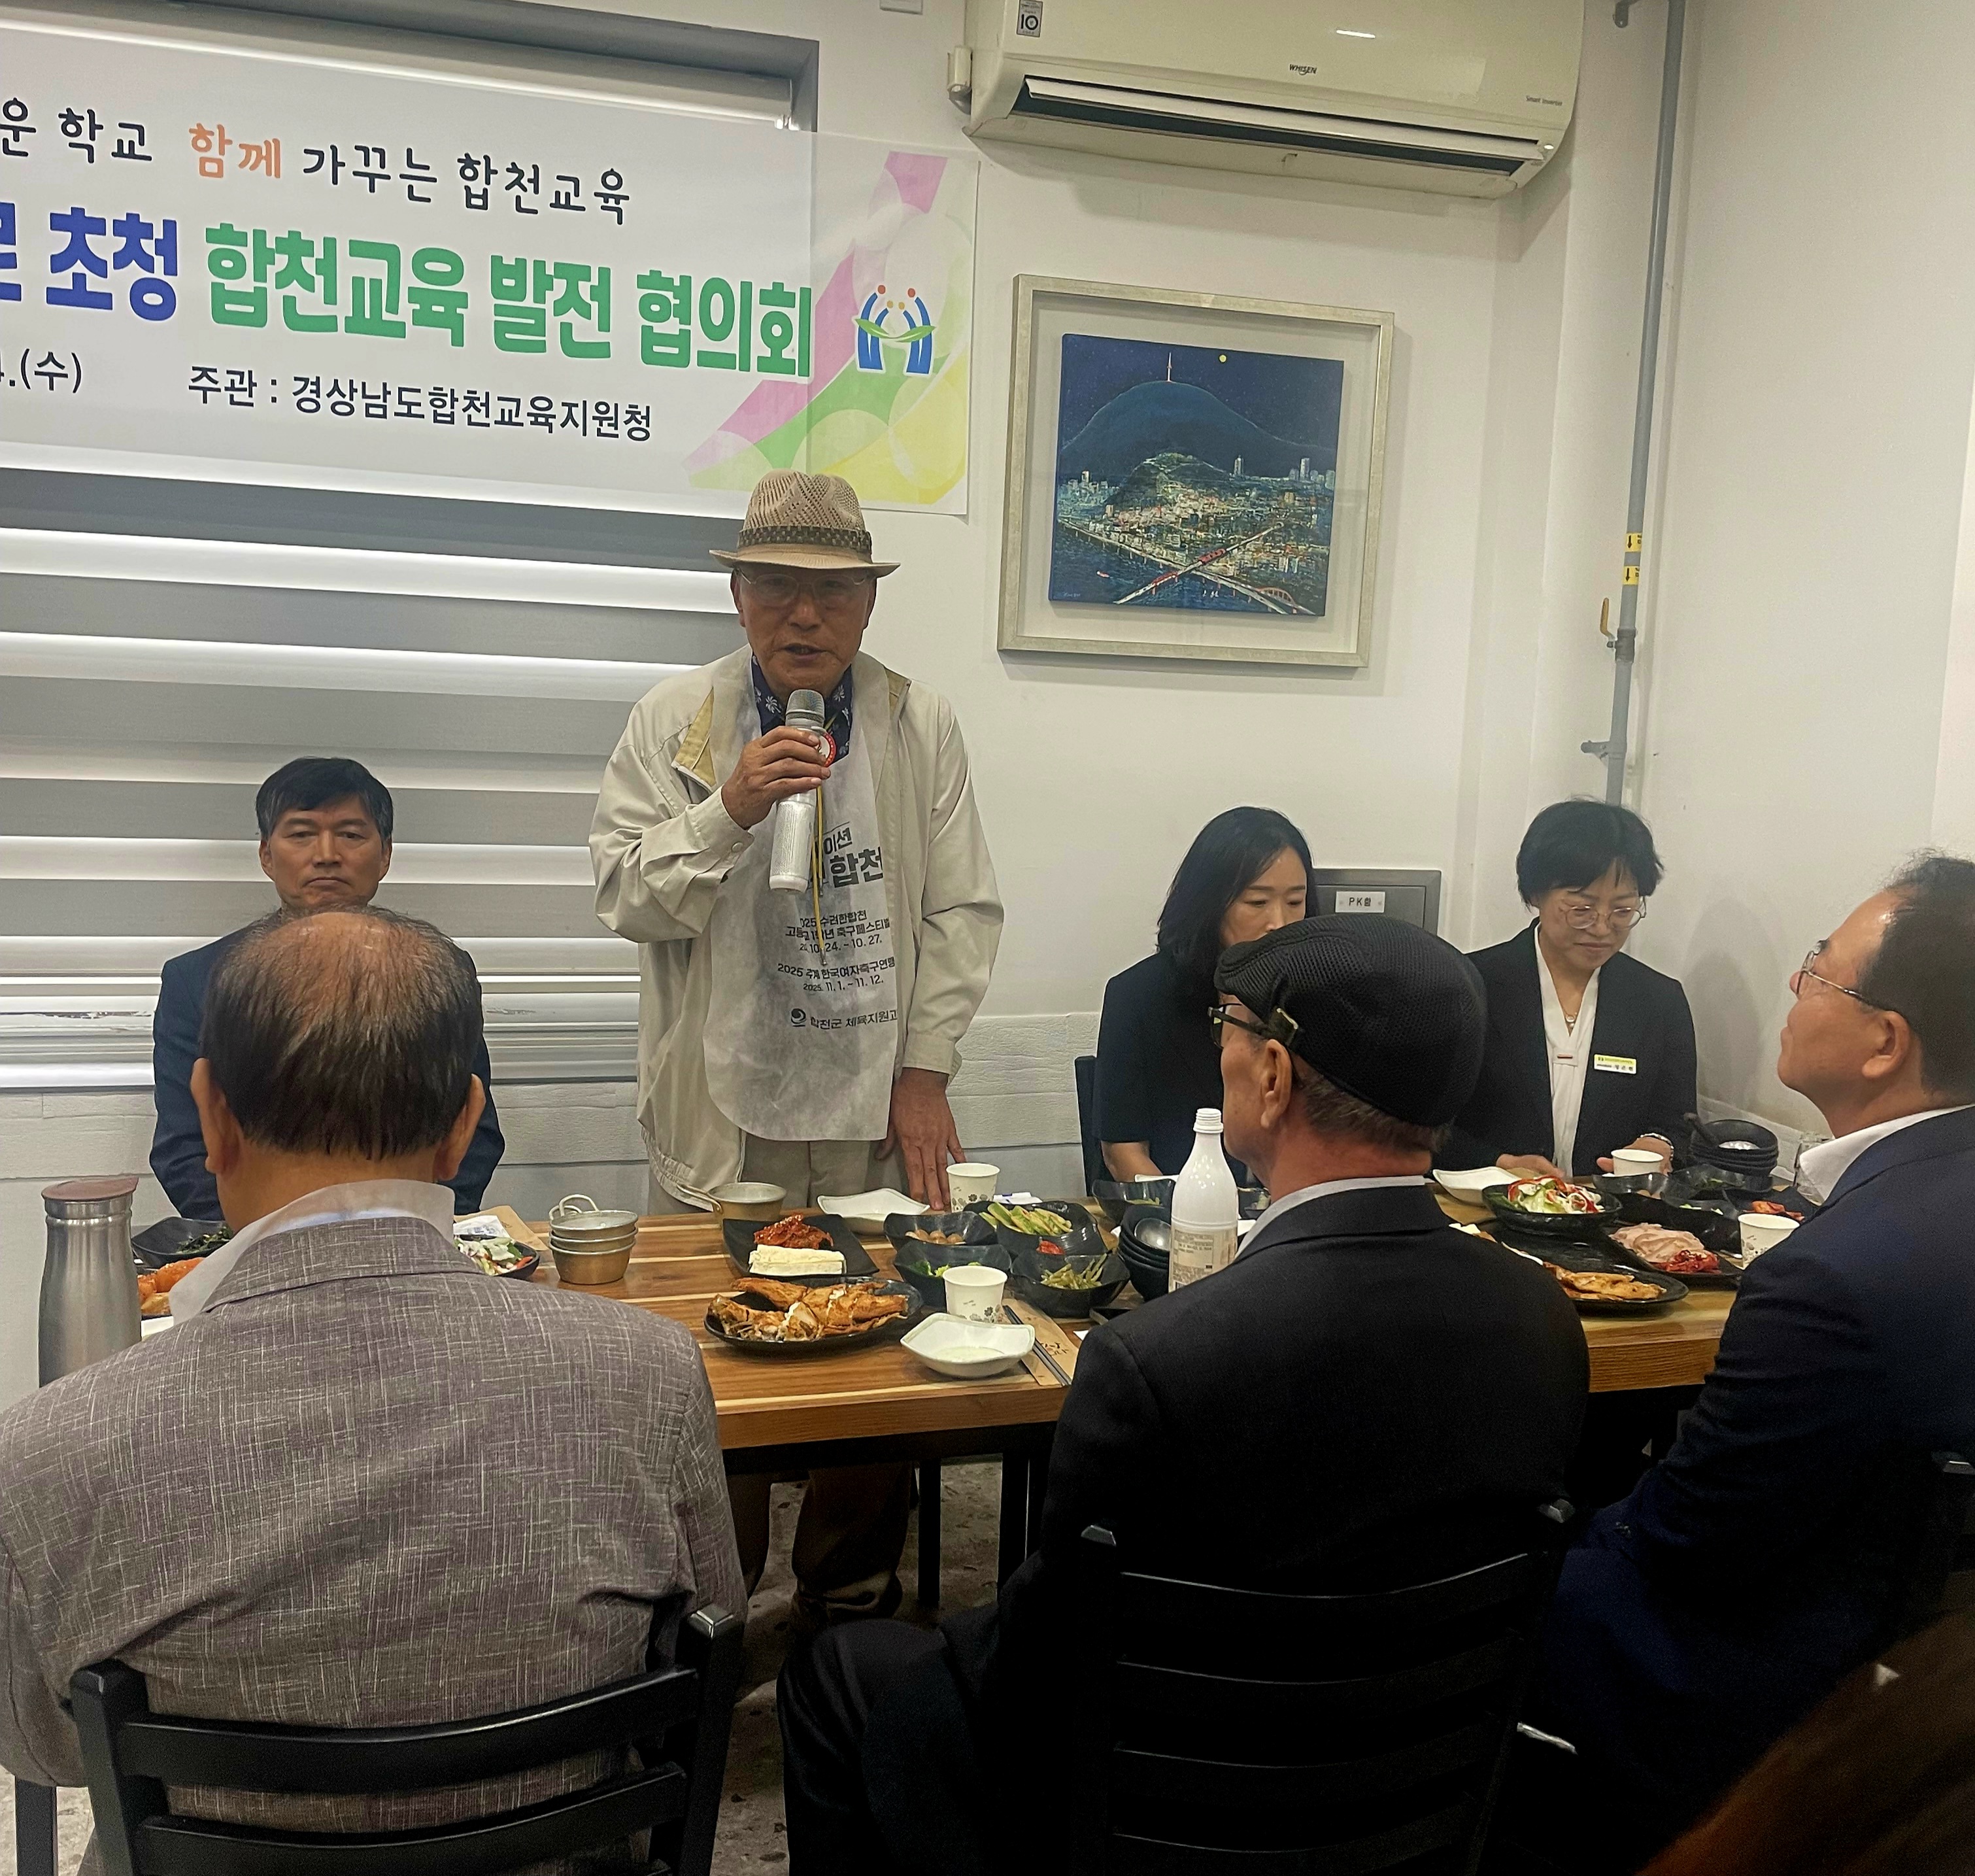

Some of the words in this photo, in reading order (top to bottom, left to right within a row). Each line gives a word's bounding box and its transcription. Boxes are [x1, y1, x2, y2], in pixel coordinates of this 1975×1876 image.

[1289, 63, 1317, 75] WHISEN
[58, 107, 153, 163] 학교
[188, 122, 282, 179] 함께
[303, 145, 437, 203] 가꾸는
[458, 152, 631, 225] 합천교육
[46, 206, 179, 322] 초청
[205, 222, 469, 348] 합천교육
[490, 254, 613, 360] 발전
[636, 269, 812, 378] 협의회
[188, 366, 258, 407] 주관
[292, 375, 652, 441] 경상남도합천교육지원청
[814, 827, 852, 855] 이션
[811, 846, 883, 888] 합천
[777, 963, 803, 977] 2025
